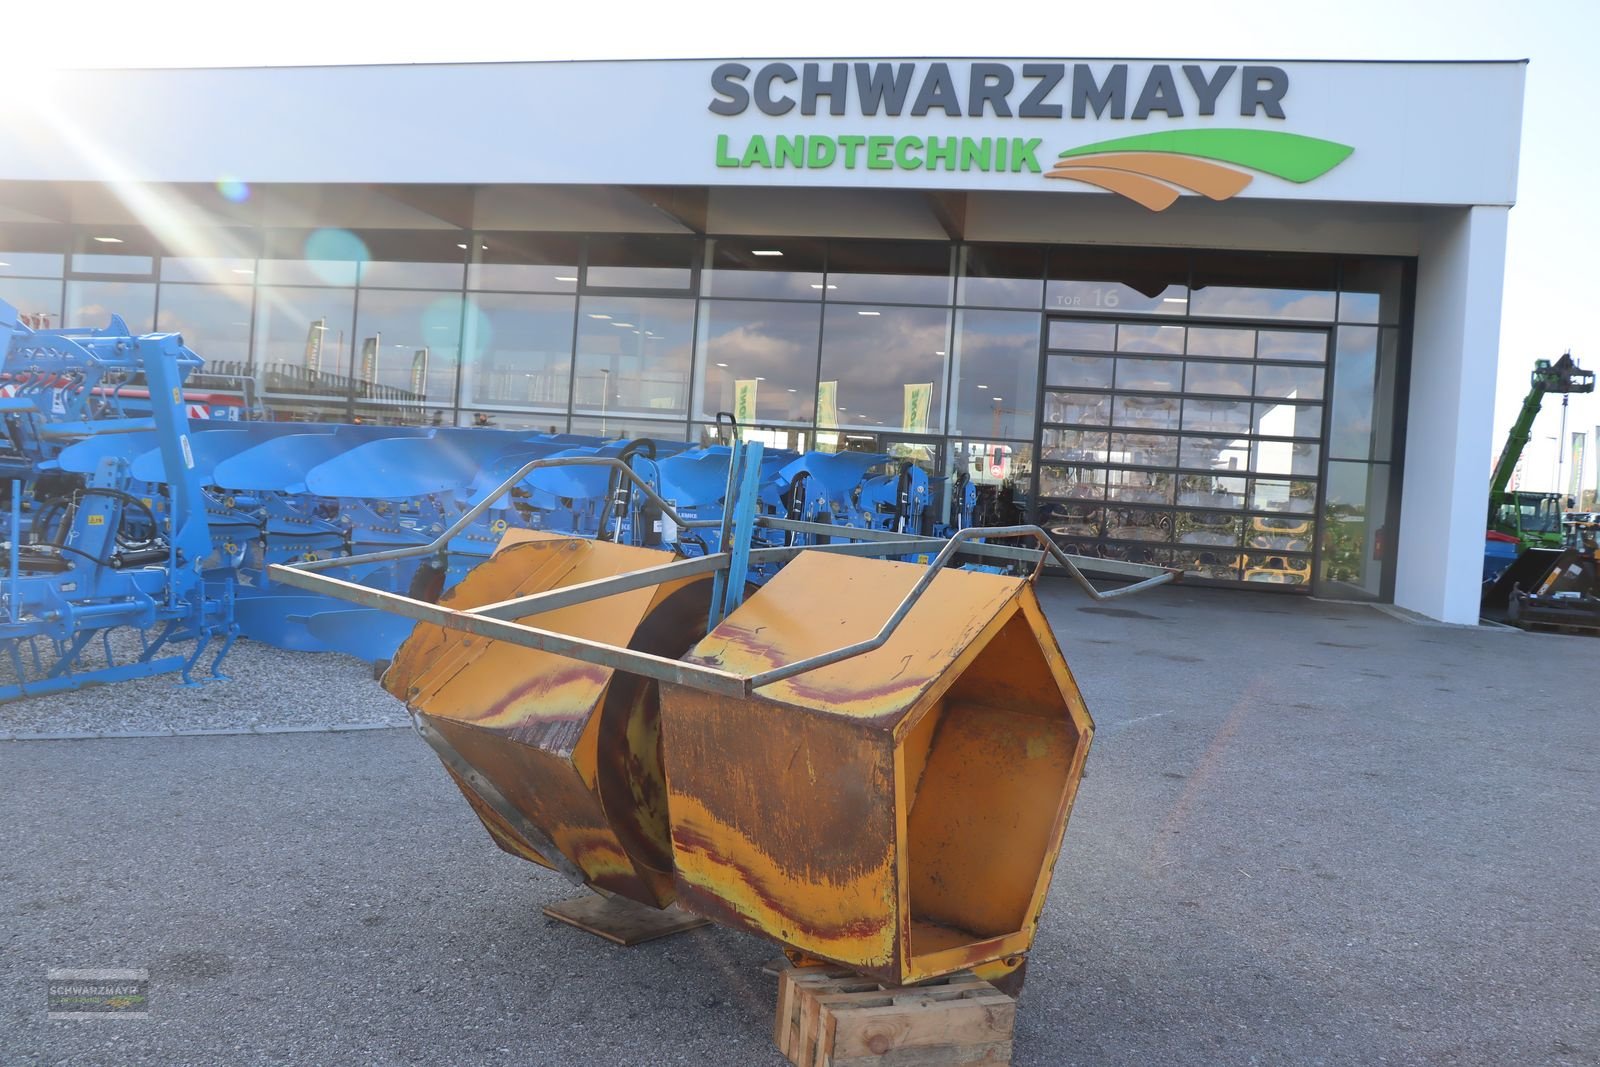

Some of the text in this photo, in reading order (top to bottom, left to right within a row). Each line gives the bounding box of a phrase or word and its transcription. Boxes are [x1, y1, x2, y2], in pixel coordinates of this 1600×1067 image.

[708, 62, 1289, 120] SCHWARZMAYR
[716, 134, 1042, 173] LANDTECHNIK
[1056, 288, 1119, 308] TOR 16
